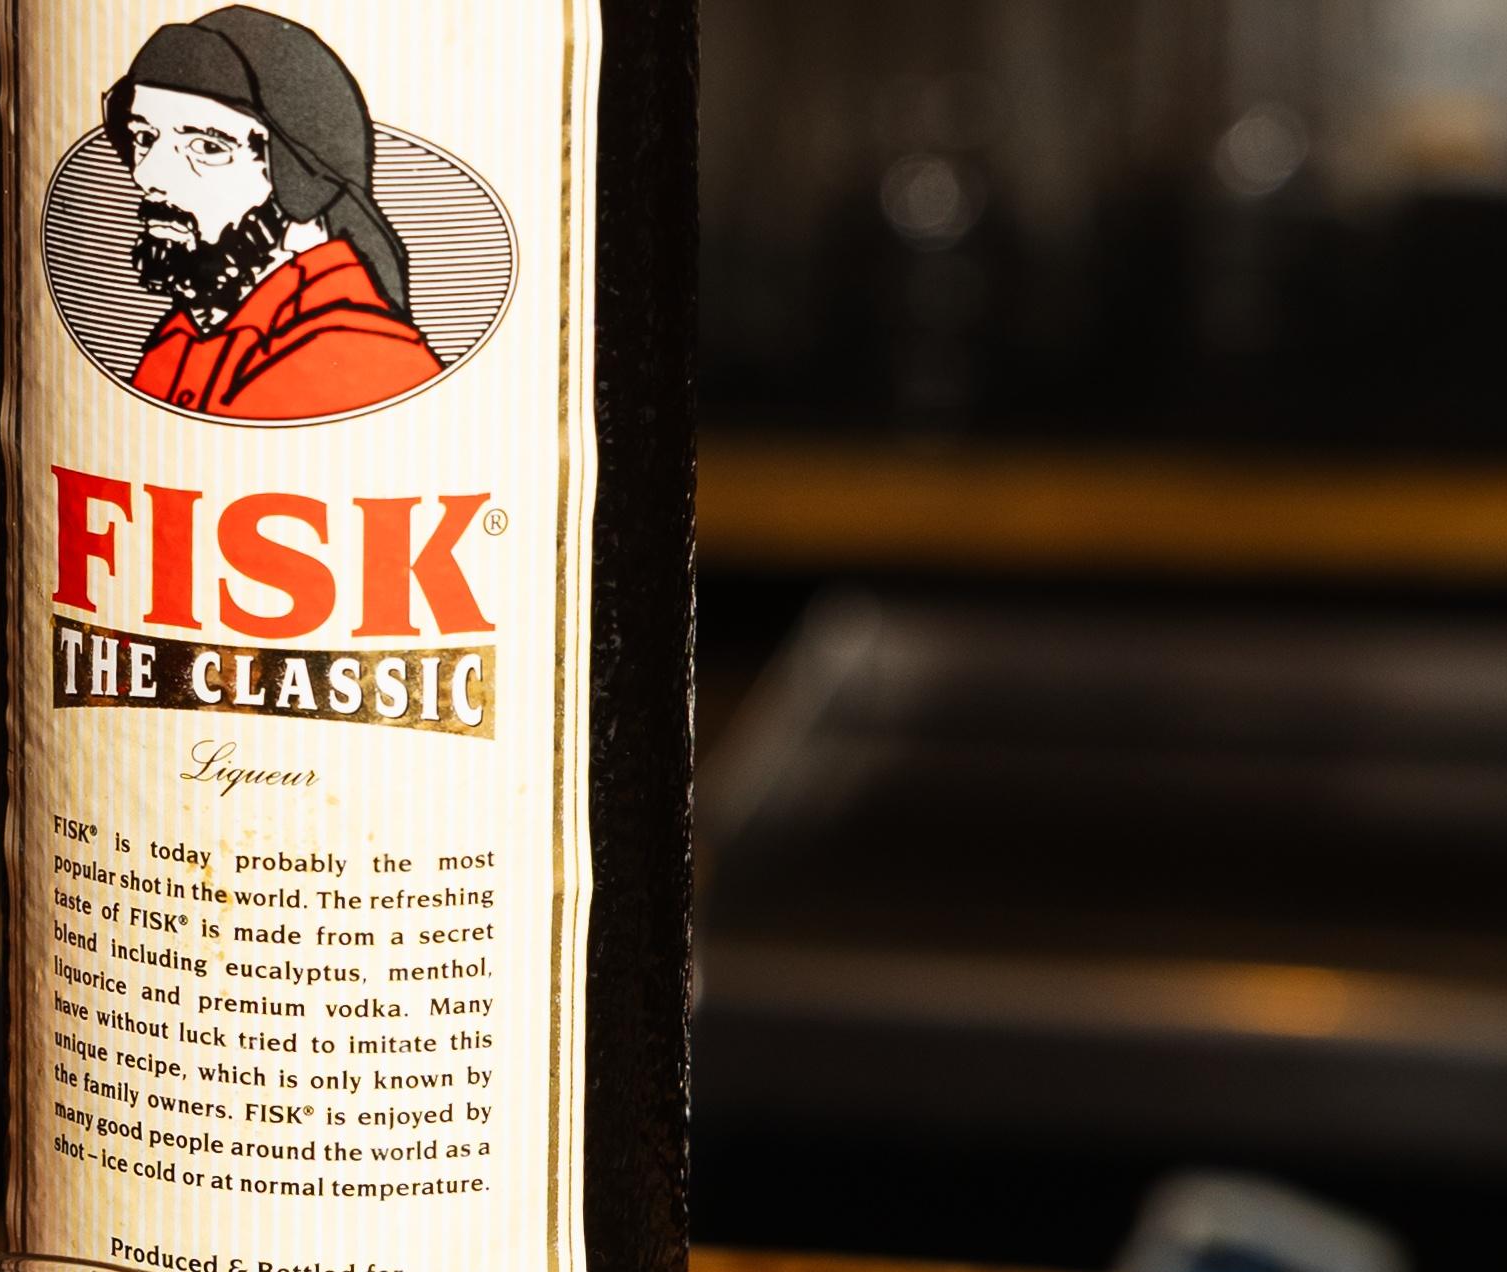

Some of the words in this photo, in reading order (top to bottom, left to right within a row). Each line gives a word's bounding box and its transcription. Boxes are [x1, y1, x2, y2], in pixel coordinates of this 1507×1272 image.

[60, 626, 157, 698] THE
[192, 649, 484, 727] CLASSIC
[180, 739, 320, 797] Liqueur
[54, 855, 116, 886] popular
[120, 870, 161, 895] shot
[166, 877, 185, 899] in
[191, 881, 228, 904] the
[234, 888, 307, 909] world.
[316, 890, 362, 909] The
[370, 888, 494, 909] refreshing
[115, 832, 130, 853] is
[150, 841, 211, 870] today
[235, 852, 346, 878] probably
[373, 853, 412, 873] the
[439, 851, 494, 870] most
[54, 887, 92, 915] taste
[101, 902, 120, 923] of
[202, 918, 220, 938] is
[234, 924, 301, 945] made
[317, 926, 374, 946] from
[391, 932, 403, 945] a
[419, 924, 494, 944] secret
[53, 915, 97, 953] blend
[111, 938, 207, 978] including
[225, 961, 366, 985] eucalyptus,
[389, 957, 492, 981] menthol,
[54, 955, 127, 995] liquorice
[141, 985, 180, 1006] and
[198, 995, 305, 1017] premium
[325, 998, 408, 1018] vodka.
[430, 998, 493, 1017] Many
[54, 990, 89, 1021] have
[96, 1009, 169, 1039] without
[179, 1022, 226, 1047] luck
[238, 1032, 297, 1053] tried
[311, 1037, 335, 1054] to
[350, 1035, 437, 1054] imitate
[450, 1031, 492, 1050] this
[54, 1031, 108, 1062] unique
[116, 1051, 186, 1080] recipe,
[198, 1063, 266, 1086] which
[279, 1069, 298, 1088] is
[310, 1070, 361, 1094] only
[374, 1070, 453, 1089] known
[467, 1066, 492, 1088] by
[54, 1062, 78, 1088] the
[83, 1072, 139, 1108] family
[147, 1094, 233, 1119] owners.
[327, 1107, 346, 1126] is
[358, 1103, 453, 1130] enjoyed
[467, 1102, 491, 1124] by
[54, 1101, 94, 1132] many
[96, 1117, 143, 1141] good
[149, 1130, 224, 1155] people
[231, 1141, 315, 1160] around
[324, 1142, 362, 1161] the
[371, 1140, 437, 1161] world
[446, 1144, 471, 1158] as
[478, 1142, 490, 1155] a
[54, 1133, 85, 1161] shot
[102, 1148, 128, 1173] ice
[133, 1160, 176, 1183] cold
[182, 1172, 205, 1187] or
[211, 1174, 233, 1191] at
[240, 1177, 323, 1196] normal
[332, 1178, 489, 1201] temperature.
